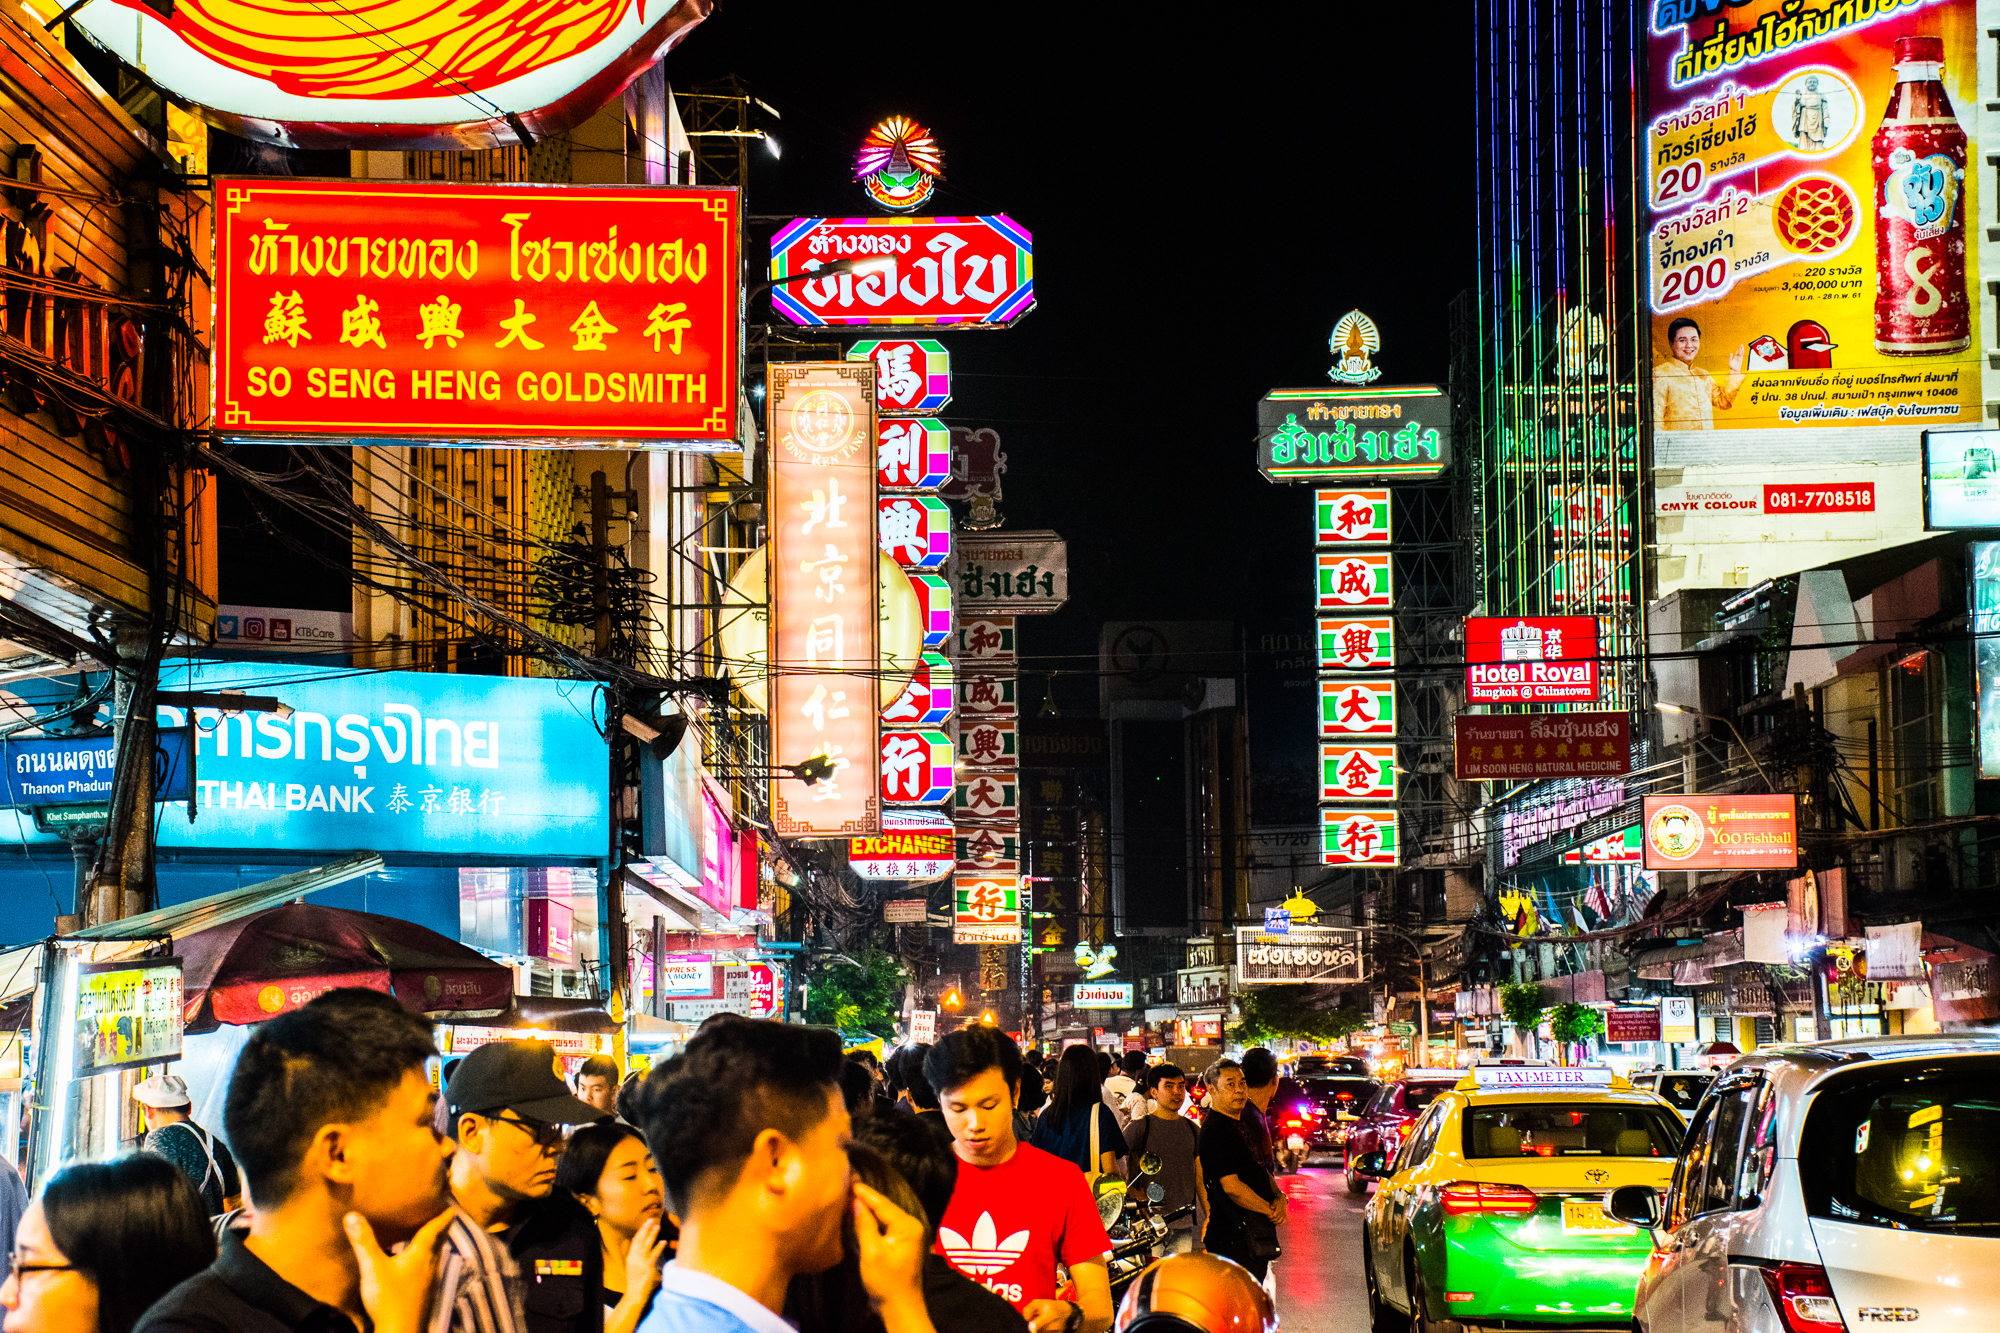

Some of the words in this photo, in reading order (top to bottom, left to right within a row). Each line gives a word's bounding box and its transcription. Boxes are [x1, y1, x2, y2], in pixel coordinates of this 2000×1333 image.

[1657, 87, 1730, 137] รางวัลที่
[1737, 94, 1746, 110] 1
[1658, 163, 1702, 202] 20
[1709, 151, 1746, 173] รางวัล
[1658, 191, 1731, 241] รางวัลที่
[1737, 198, 1748, 216] 2
[248, 217, 479, 281] ห้างขายทอง
[808, 226, 872, 255] ห้างทอง
[1661, 258, 1727, 304] 200
[1733, 251, 1770, 271] รางวัล
[1804, 267, 1826, 277] 220
[1828, 265, 1862, 276] รางวัล
[1781, 280, 1838, 292] 3,400,000
[1840, 279, 1863, 289] บาท
[247, 366, 292, 398] SO
[306, 367, 396, 400] SENG
[411, 369, 501, 402] HENG
[516, 370, 707, 404] GOLDSMITH
[1784, 392, 1798, 401] 38
[1926, 387, 1958, 397] 10406
[1306, 402, 1402, 420] ห้างขายทอง
[811, 452, 839, 467] REN
[1661, 500, 1699, 512] CMYK
[1704, 499, 1757, 510] COLOUR
[1769, 490, 1871, 508] 081-7708518
[295, 627, 335, 638] KTBCare
[1471, 663, 1526, 683] Hotel
[1531, 662, 1592, 683] Royal
[1472, 686, 1519, 700] Bangkok
[1520, 687, 1533, 699] @
[1534, 685, 1592, 697] Chinatown
[1465, 764, 1481, 774] LIM
[1482, 763, 1508, 774] SOON
[1509, 763, 1534, 773] HENG
[1535, 761, 1576, 773] NATURAL
[1577, 760, 1622, 772] MEDICINE
[21, 782, 65, 795] Thanon
[198, 780, 275, 811] THAI
[286, 783, 375, 814] BANK
[385, 783, 506, 818] 泰京银行
[47, 812, 62, 822] Khet
[851, 834, 952, 855] EXCHANGE
[1744, 832, 1792, 844] Fishball
[1858, 1307, 1920, 1323] FREED
